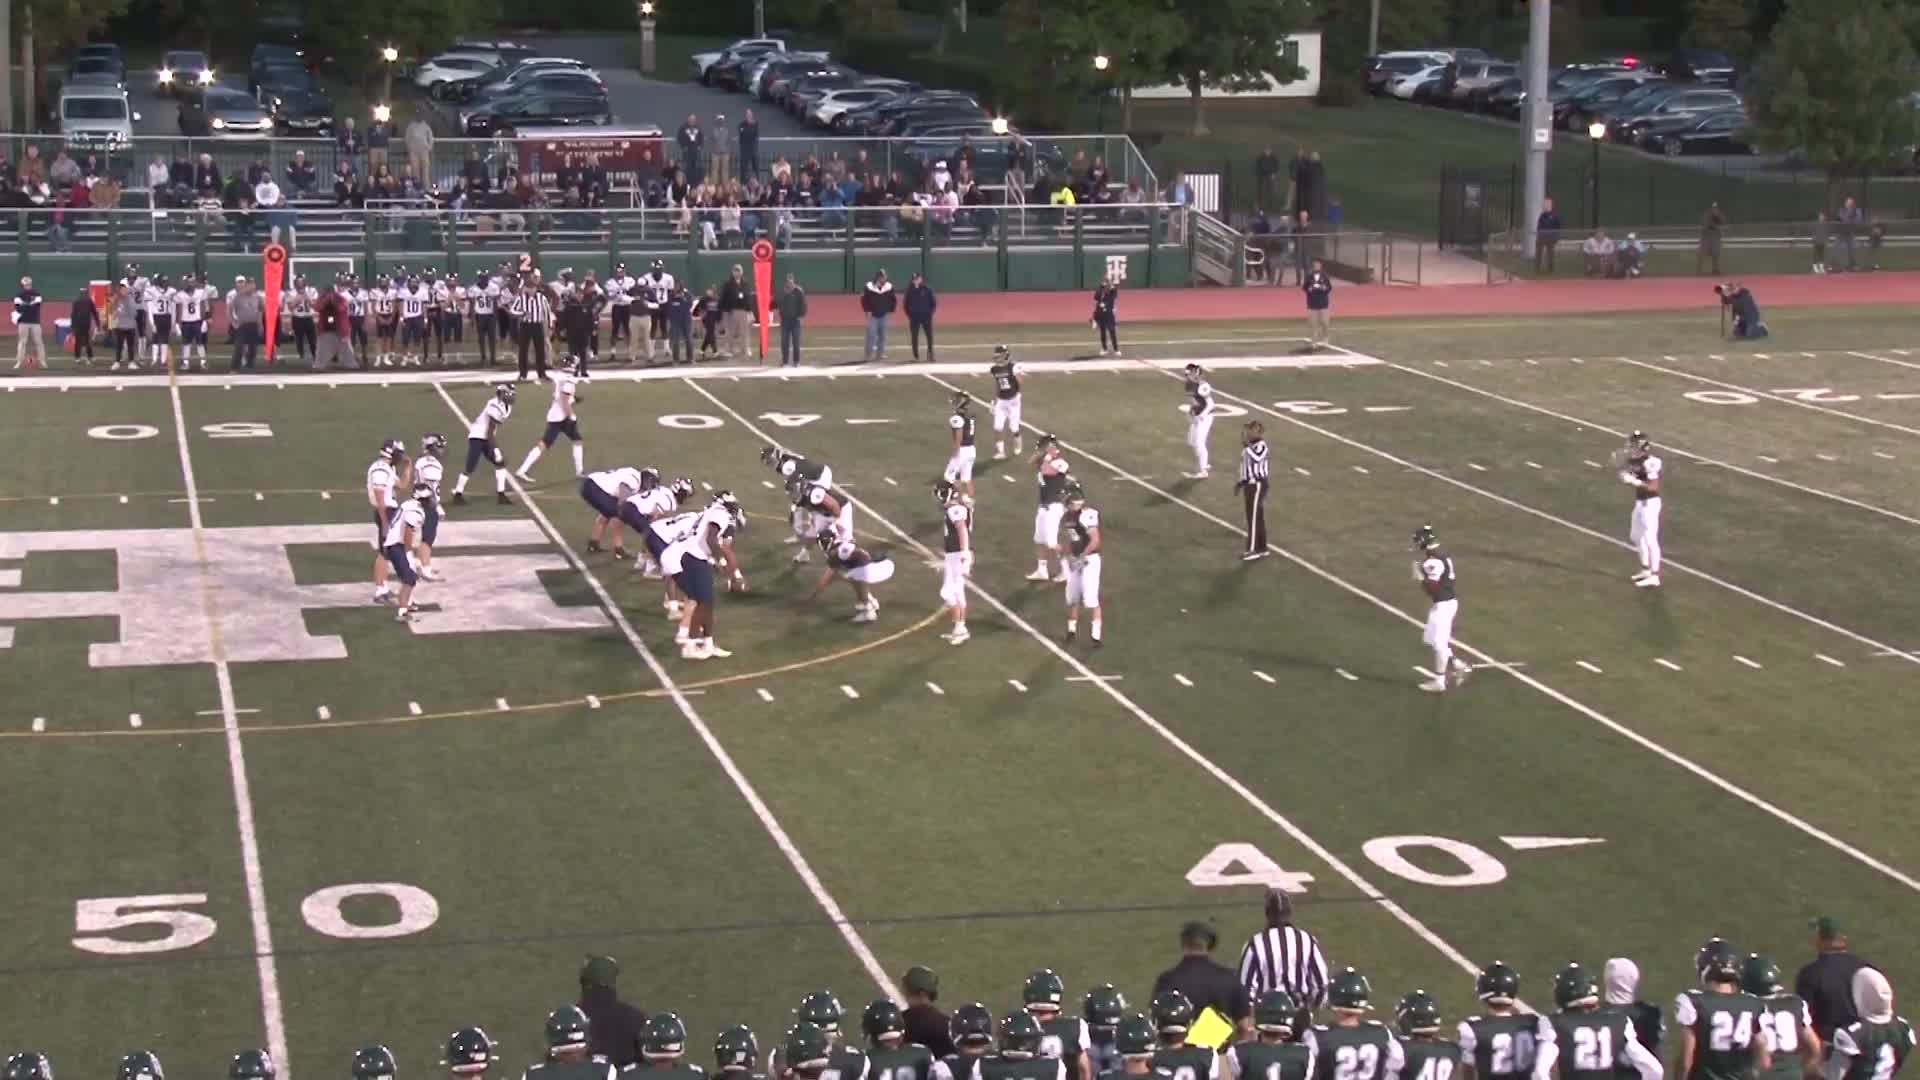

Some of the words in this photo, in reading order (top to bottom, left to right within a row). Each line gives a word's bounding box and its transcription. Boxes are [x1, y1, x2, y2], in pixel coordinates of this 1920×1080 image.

[520, 256, 531, 271] 2
[1573, 1026, 1614, 1070] 21
[1709, 1011, 1753, 1051] 24
[1334, 1043, 1379, 1080] 23
[1491, 1032, 1535, 1073] 20
